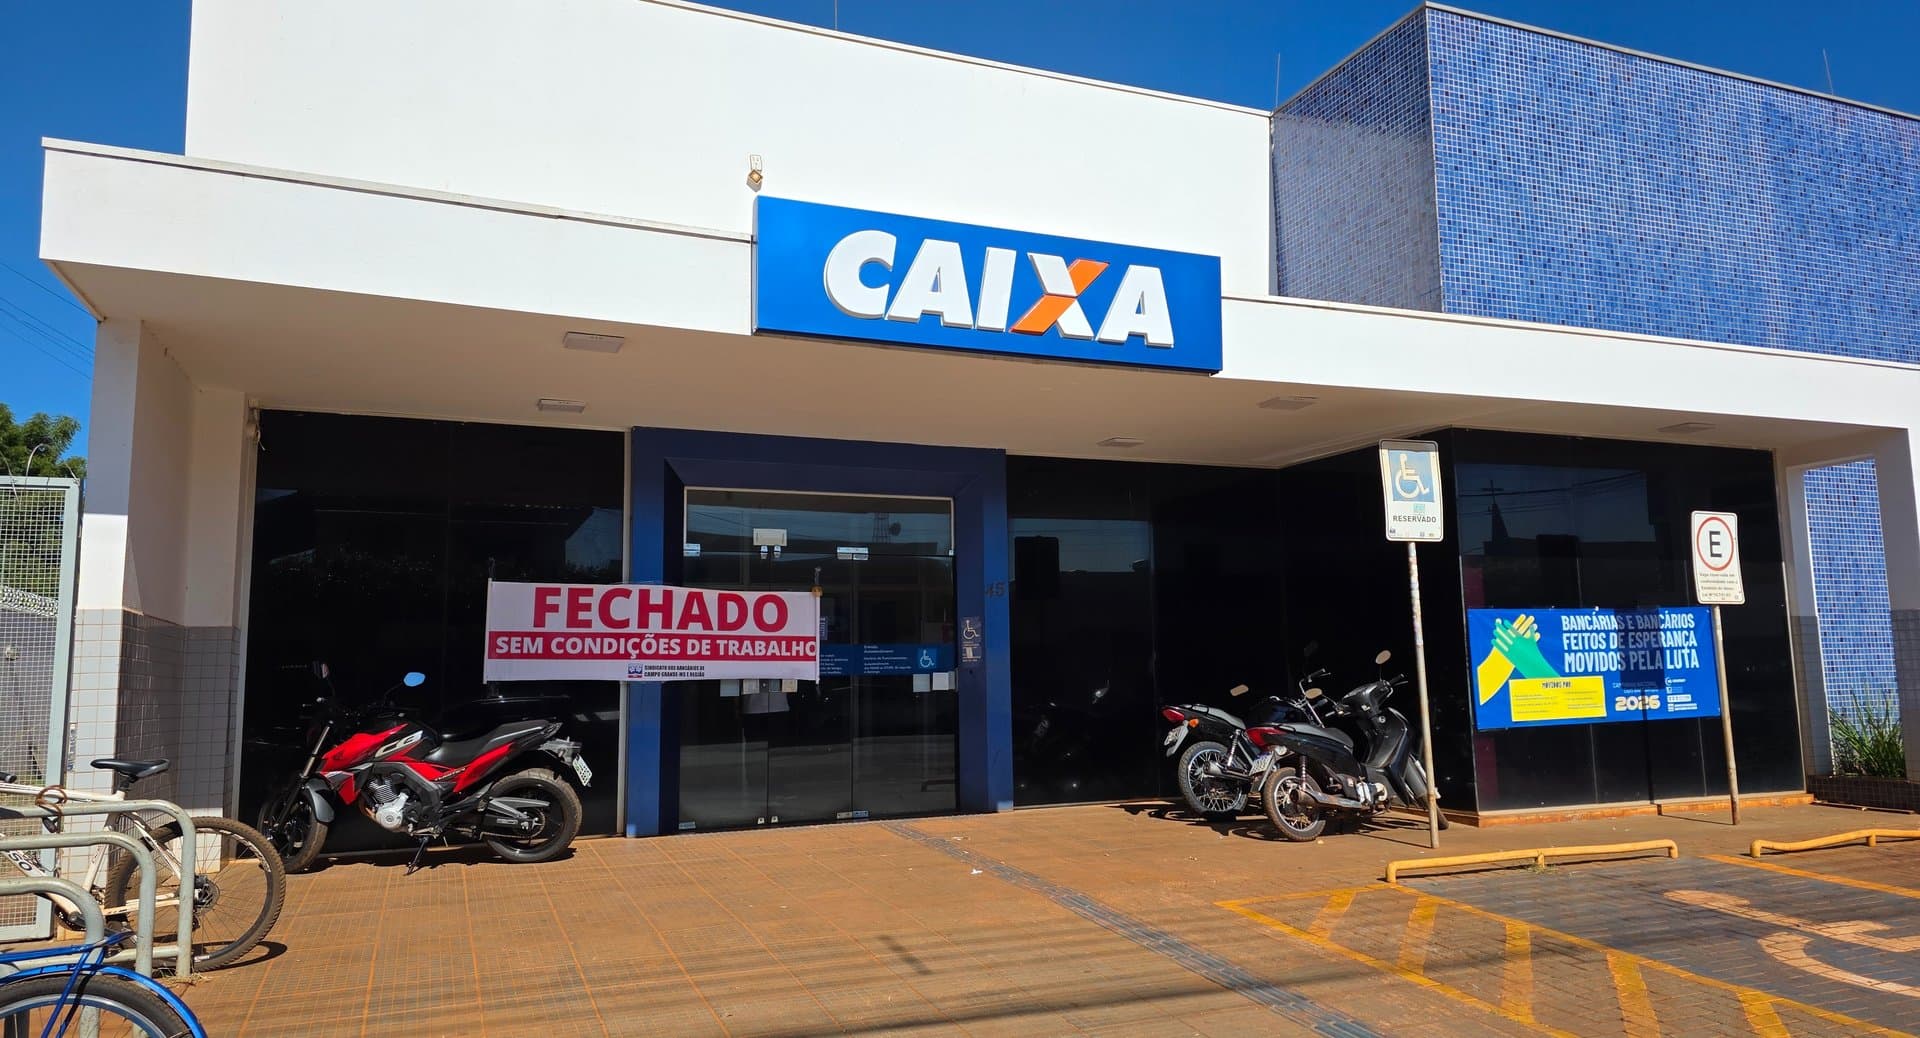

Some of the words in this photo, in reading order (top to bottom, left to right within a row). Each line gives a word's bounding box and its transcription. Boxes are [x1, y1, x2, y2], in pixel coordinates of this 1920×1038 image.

[823, 229, 1175, 349] CAIXA
[1392, 515, 1437, 524] RESERVADO
[1709, 530, 1722, 558] E
[533, 586, 788, 633] FECHADO
[1561, 611, 1626, 631] BANCÁRIAS
[1628, 615, 1636, 630] E
[1637, 610, 1695, 629] BANCÁRIOS
[495, 636, 543, 654] SEM
[550, 633, 681, 659] CONDIÇÕES
[687, 639, 711, 656] DE
[716, 640, 816, 657] TRABALHO
[1563, 632, 1606, 651] FEITOS
[1609, 632, 1625, 649] DE
[1628, 630, 1698, 649] ESPERANÇA
[1564, 651, 1626, 673] MOVIDOS
[1629, 650, 1664, 671] PELA
[1666, 648, 1700, 669] LUTA
[1615, 694, 1661, 712] 2026
